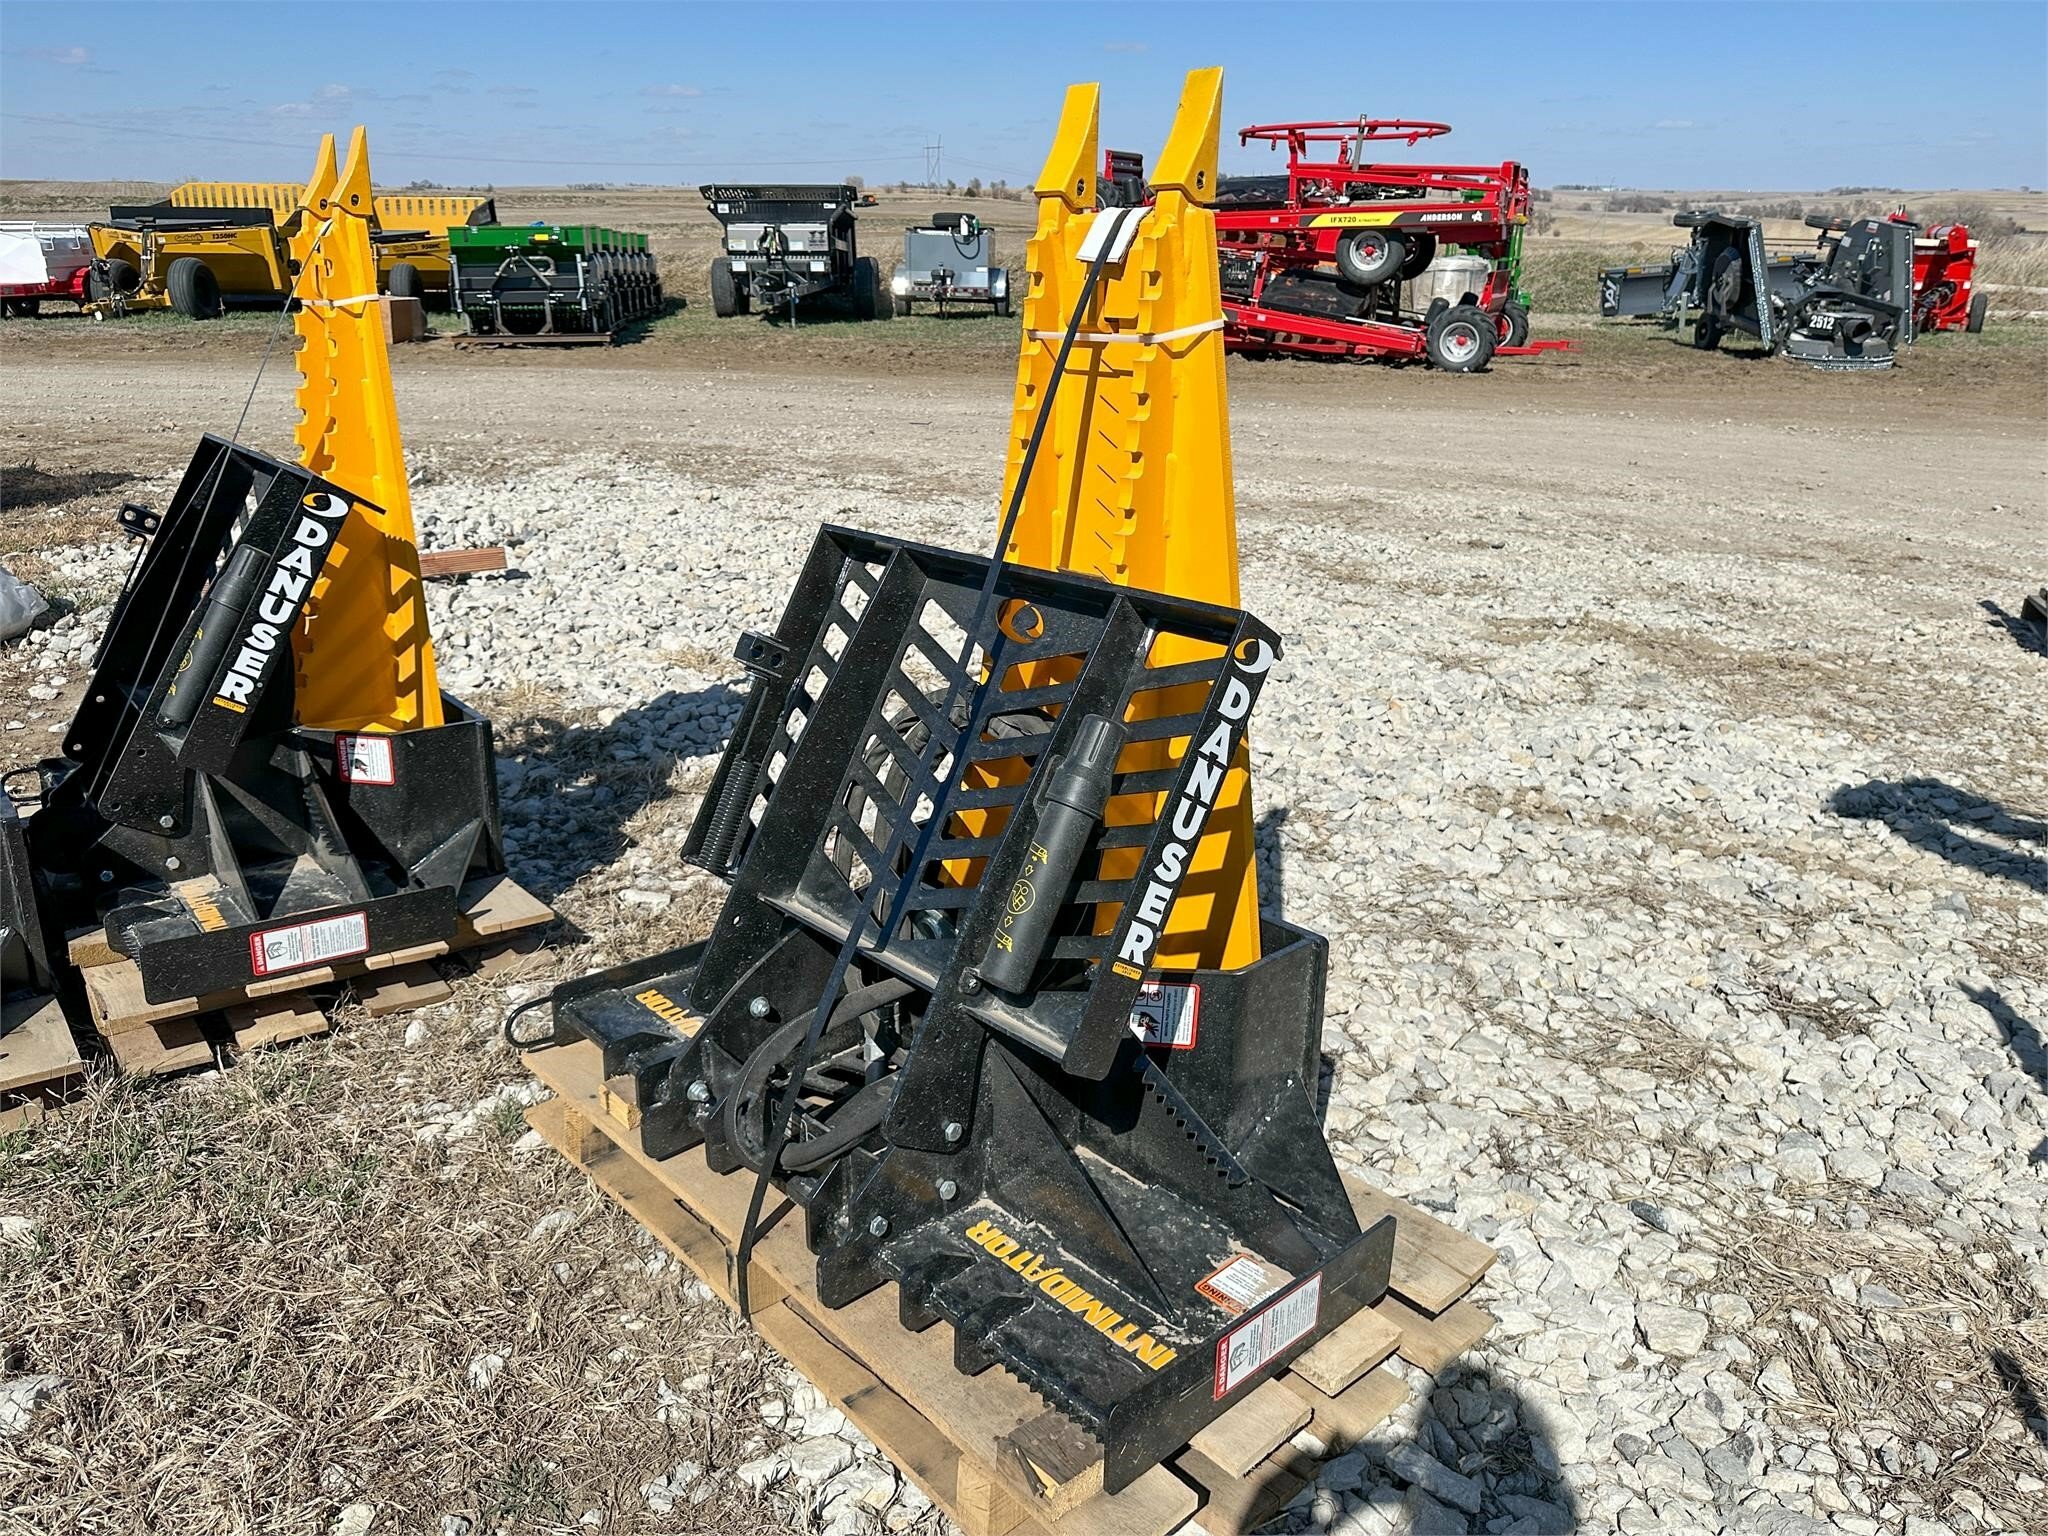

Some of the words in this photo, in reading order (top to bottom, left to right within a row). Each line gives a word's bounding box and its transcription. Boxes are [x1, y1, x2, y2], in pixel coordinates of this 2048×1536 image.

[1330, 216, 1357, 224] IFX720
[1419, 213, 1463, 222] ANDERSON
[212, 232, 238, 240] 1350HC
[1808, 314, 1835, 330] 2512
[217, 515, 329, 705] DANUSER
[1117, 676, 1251, 967] DANUSER
[254, 935, 265, 966] DANGER
[966, 1219, 1178, 1371] INTIMIDATOR
[1218, 1341, 1229, 1384] DANGER
